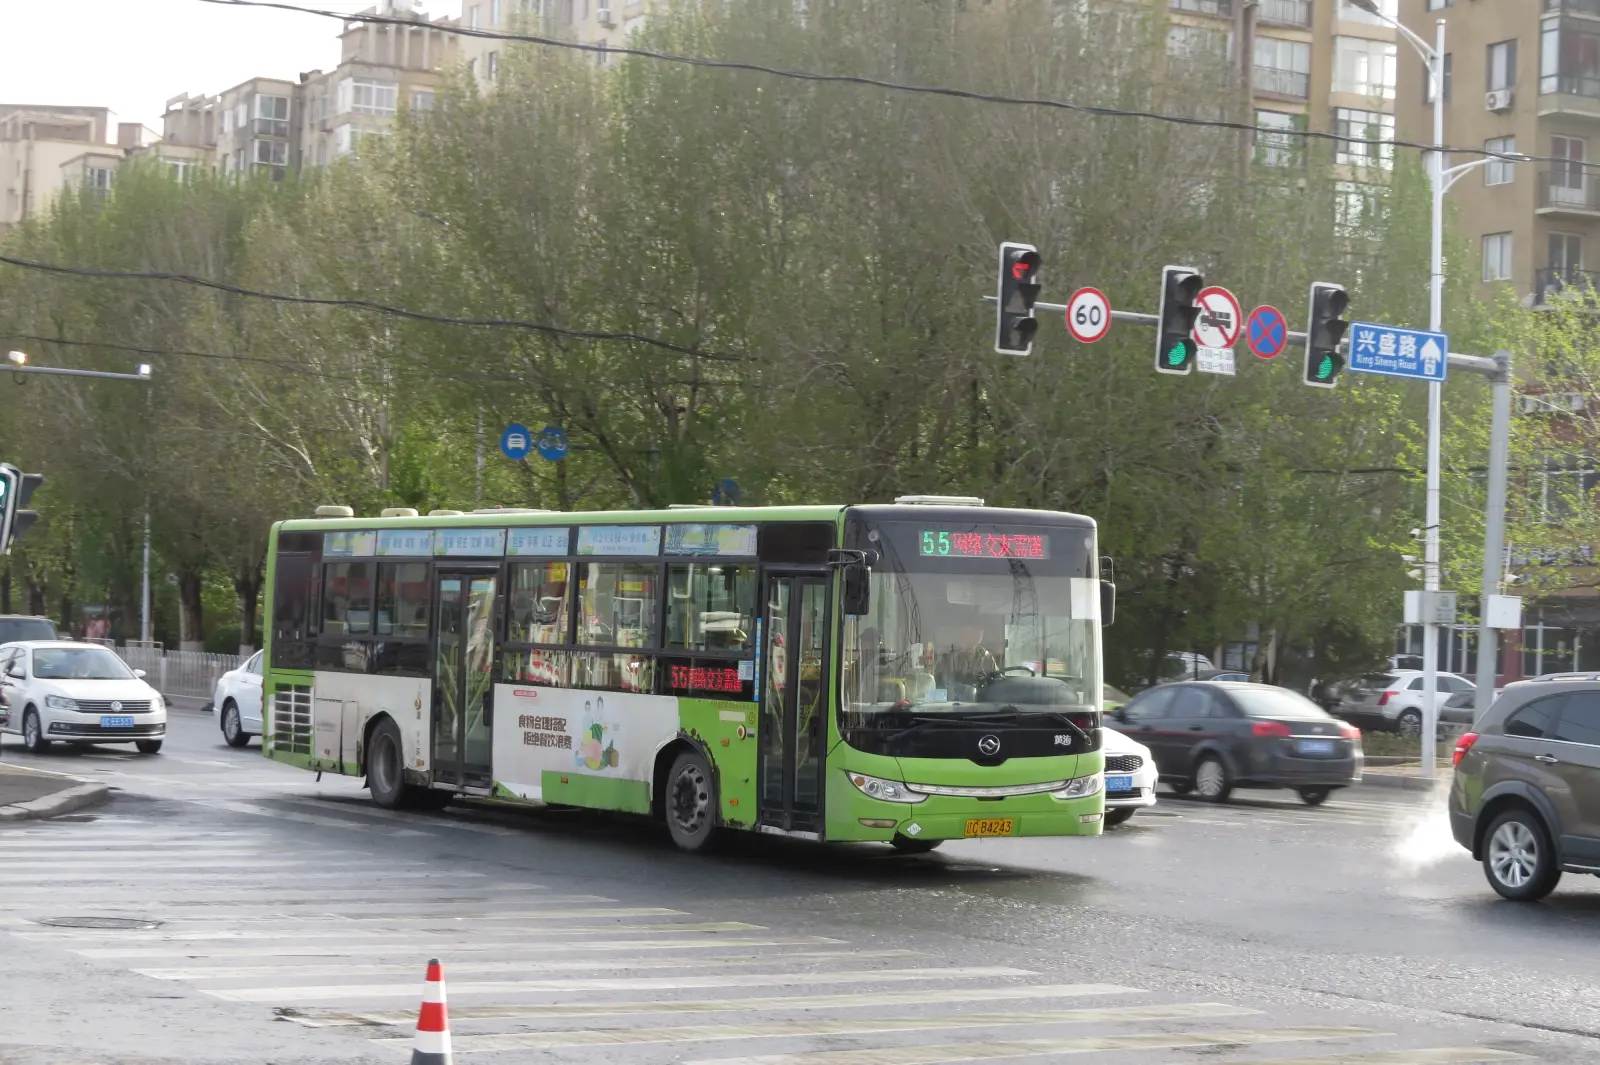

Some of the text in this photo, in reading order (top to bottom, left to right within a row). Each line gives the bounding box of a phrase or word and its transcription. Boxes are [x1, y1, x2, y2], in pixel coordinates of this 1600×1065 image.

[1076, 305, 1101, 326] 60
[1357, 330, 1418, 358] 兴盛路
[1355, 354, 1374, 368] Xing
[923, 531, 951, 555] 55
[671, 666, 688, 688] 55
[518, 713, 567, 733] 食物合理搭配
[523, 731, 573, 750] 拒绝餐饮浪费
[1053, 734, 1072, 746] 黄海
